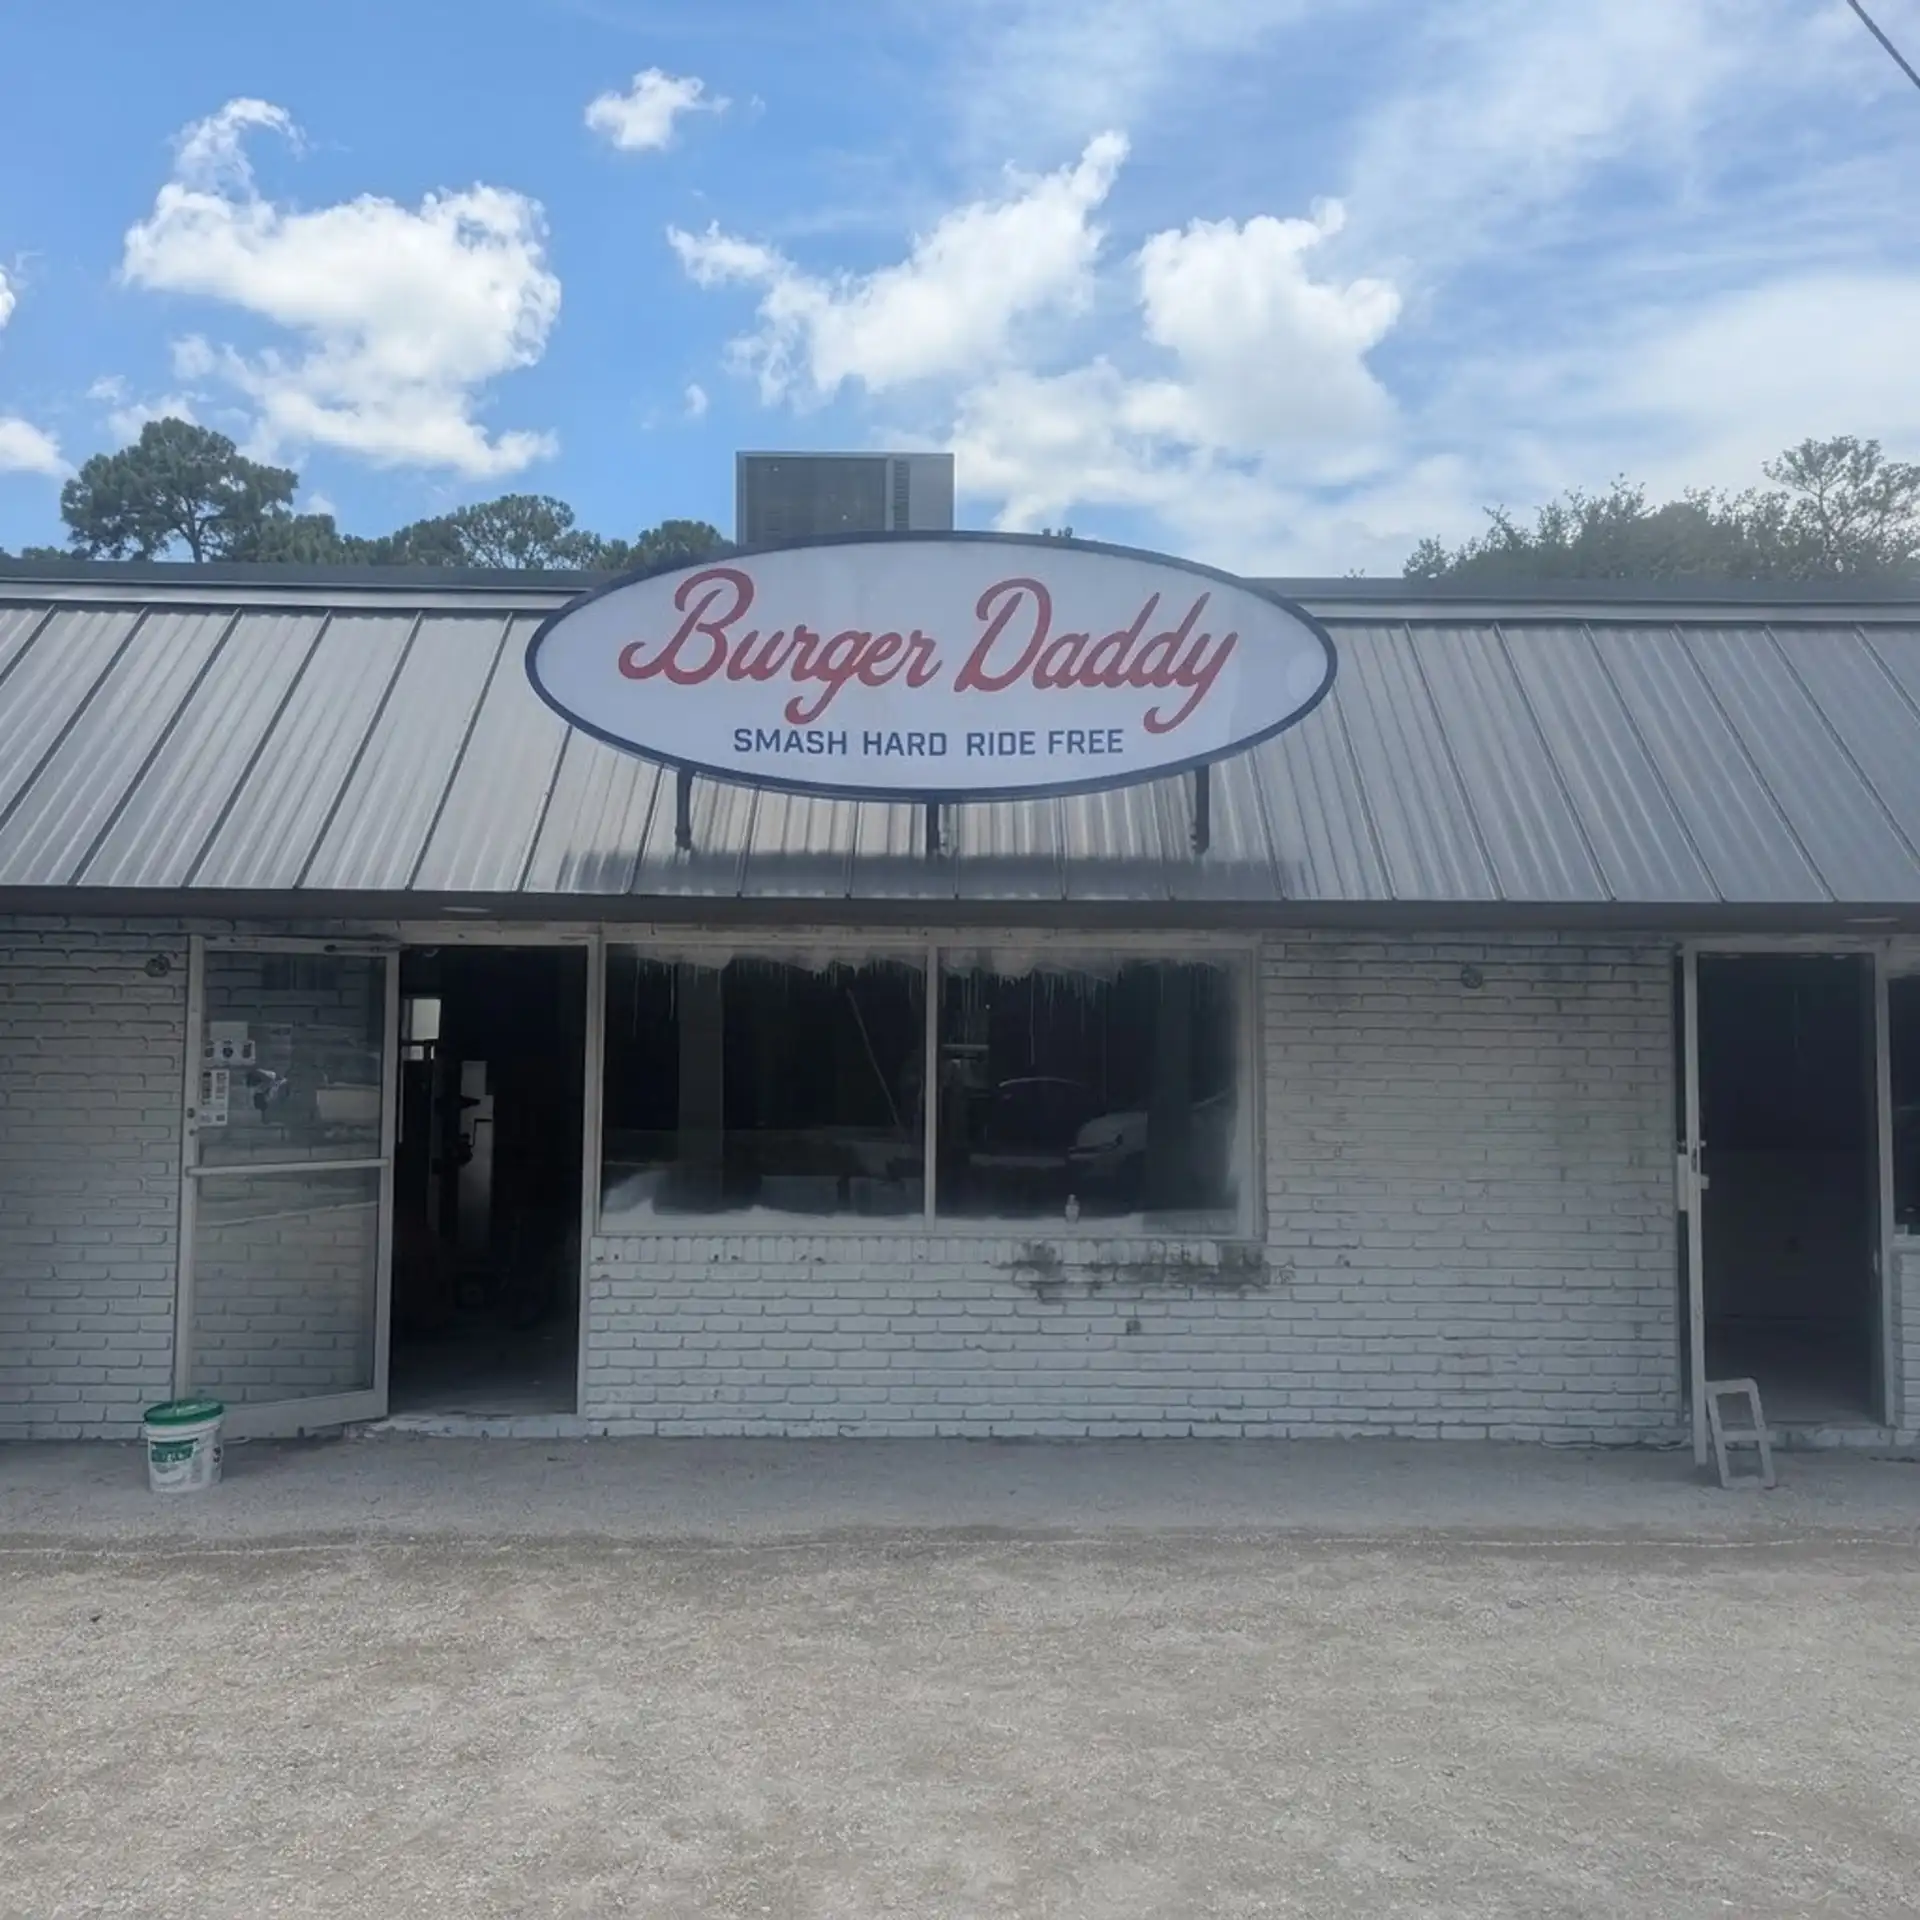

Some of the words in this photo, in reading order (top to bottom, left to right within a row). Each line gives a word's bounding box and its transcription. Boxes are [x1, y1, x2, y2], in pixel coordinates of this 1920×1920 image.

[618, 567, 943, 725] Burger
[953, 577, 1239, 734] Daddy
[733, 728, 848, 755] SMASH
[863, 730, 948, 756] HARD
[966, 731, 1037, 756] RIDE
[1048, 729, 1124, 755] FREE
